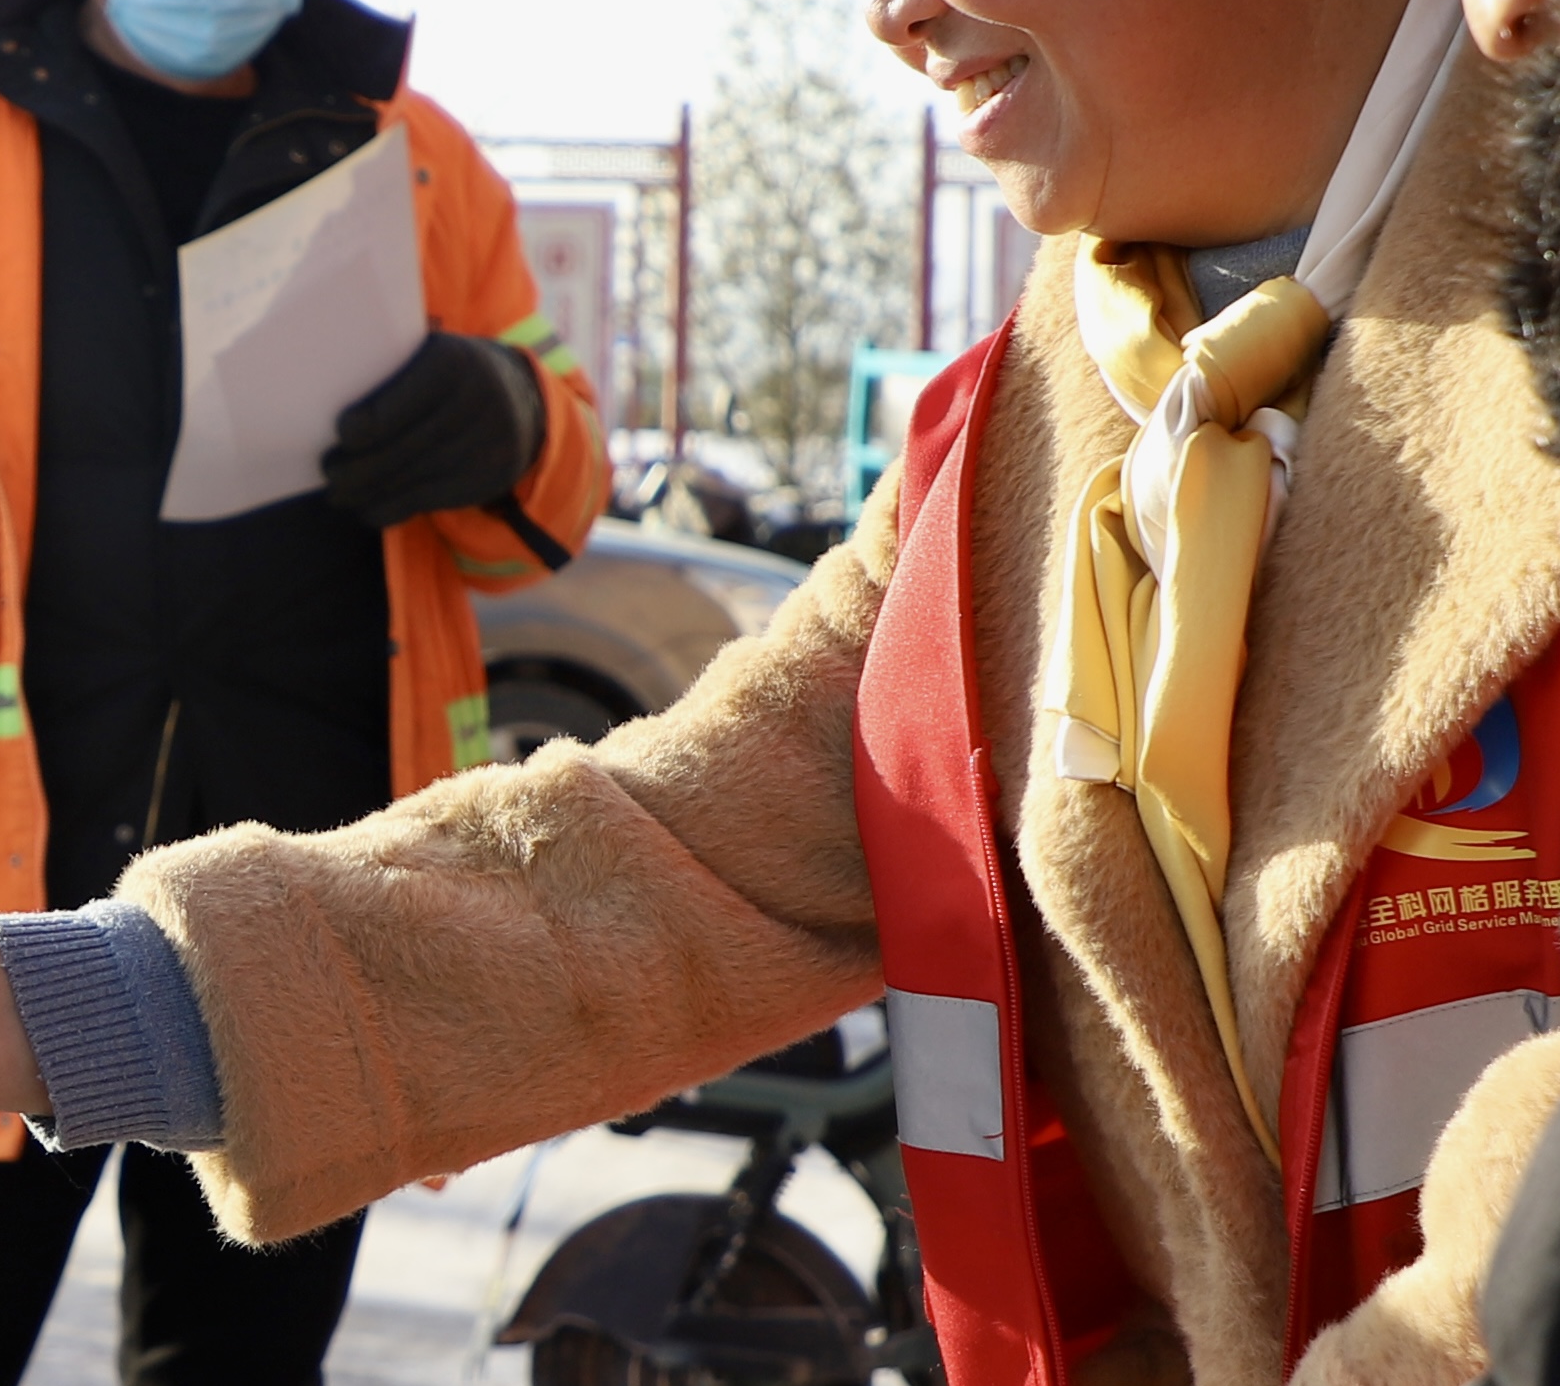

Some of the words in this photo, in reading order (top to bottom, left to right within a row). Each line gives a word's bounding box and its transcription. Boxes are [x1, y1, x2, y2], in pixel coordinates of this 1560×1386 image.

[1369, 924, 1420, 945] Global
[1423, 918, 1456, 935] Grid
[1458, 915, 1517, 933] Service
